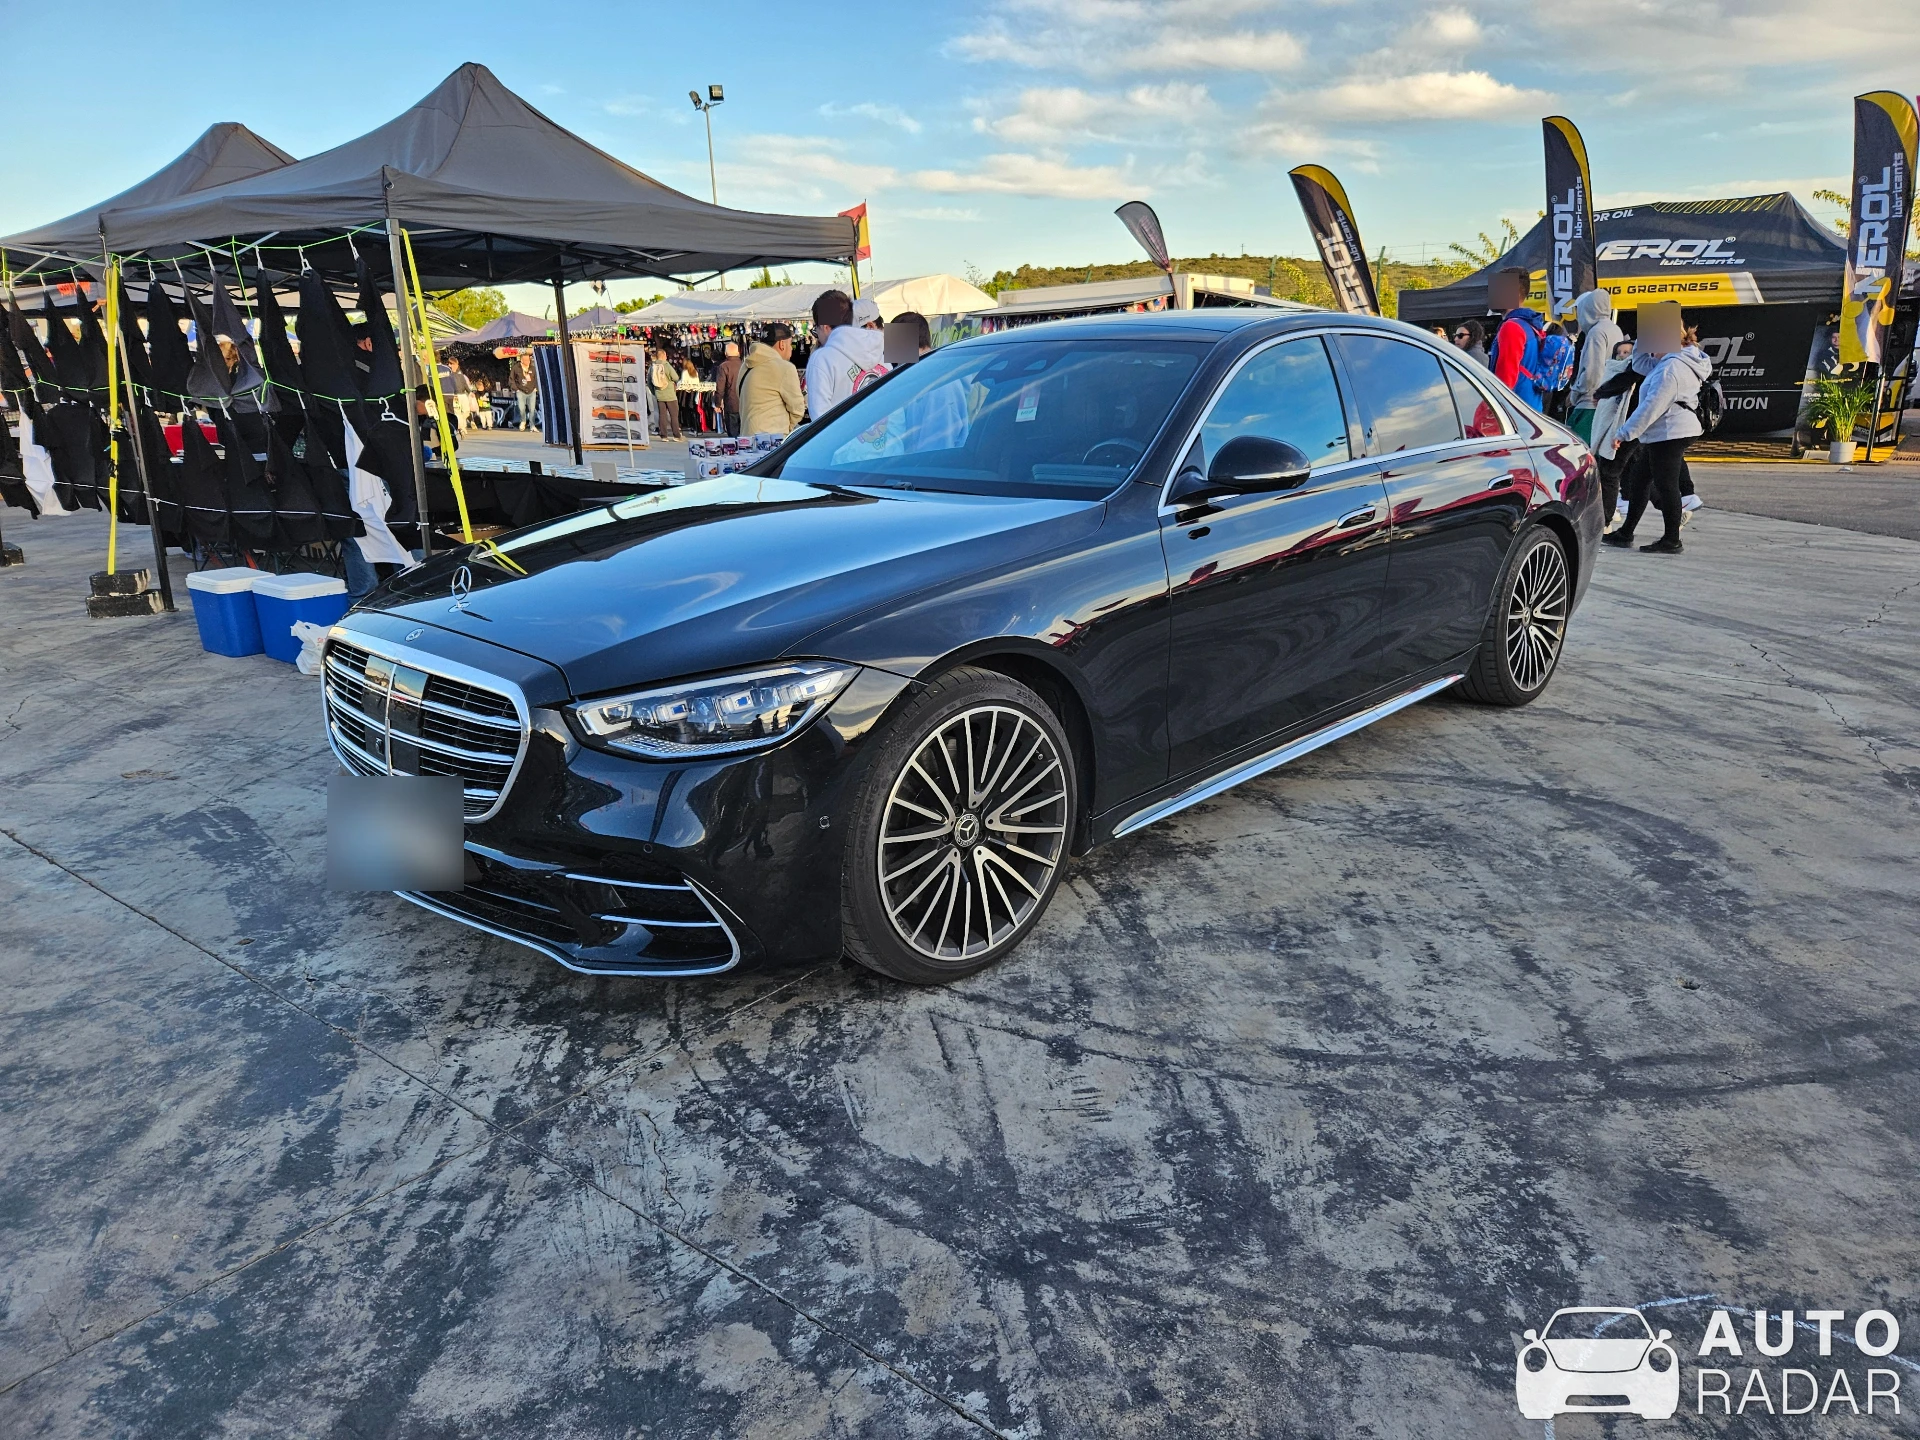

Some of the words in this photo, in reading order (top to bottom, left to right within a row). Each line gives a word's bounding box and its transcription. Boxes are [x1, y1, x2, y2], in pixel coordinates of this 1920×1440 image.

[1573, 176, 1583, 239] lubricants
[1611, 209, 1634, 219] OIL
[1892, 152, 1903, 218] lubricants
[1553, 188, 1575, 316] NEROL
[1659, 257, 1746, 266] lubricants
[1853, 166, 1891, 295] NEROL
[1320, 221, 1372, 315] EROL
